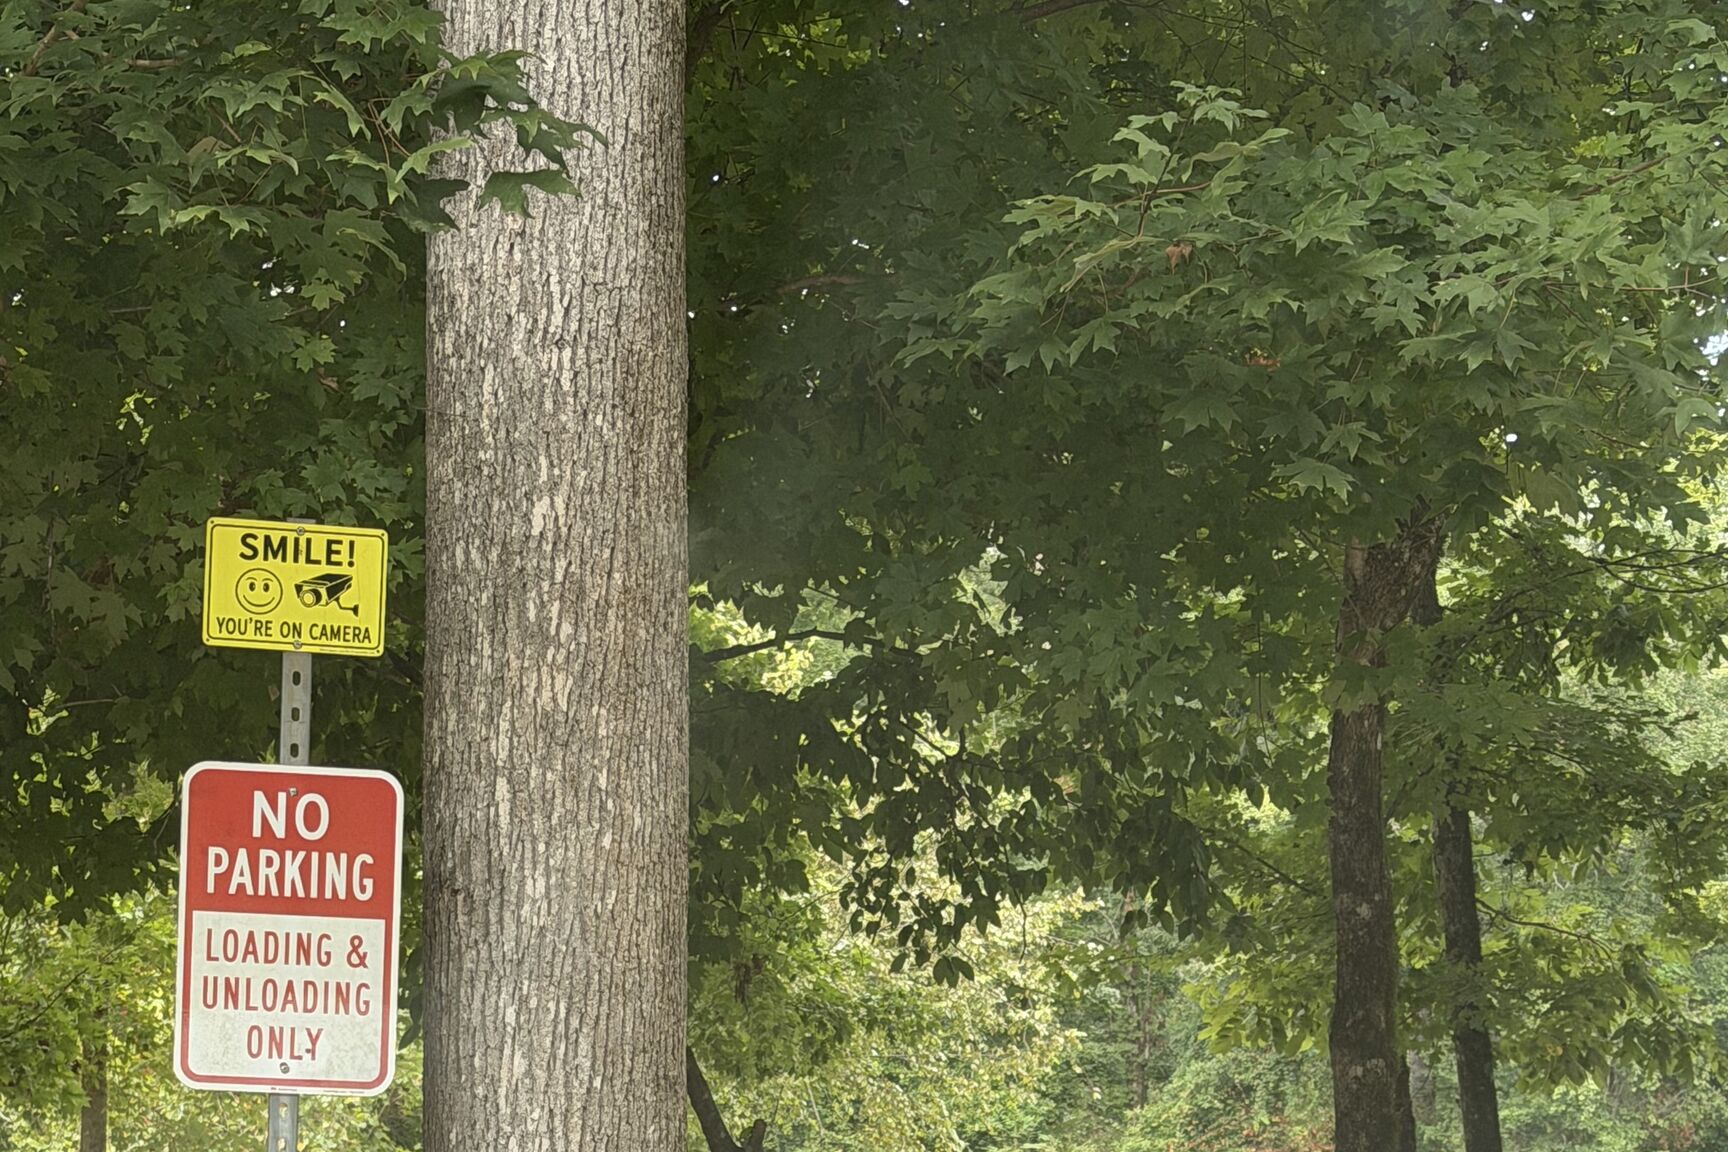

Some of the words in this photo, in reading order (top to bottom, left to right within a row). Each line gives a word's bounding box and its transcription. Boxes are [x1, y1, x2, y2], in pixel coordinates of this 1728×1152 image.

[239, 533, 355, 568] SMILE!
[216, 616, 273, 637] YOU'RE
[280, 621, 302, 639] ON
[309, 623, 372, 644] CAMERA
[252, 790, 329, 841] NO
[206, 846, 374, 901] PARKING
[206, 928, 332, 967] LOADING
[346, 935, 368, 969] &
[202, 976, 370, 1016] UNLOADING
[246, 1025, 323, 1061] ONLY
